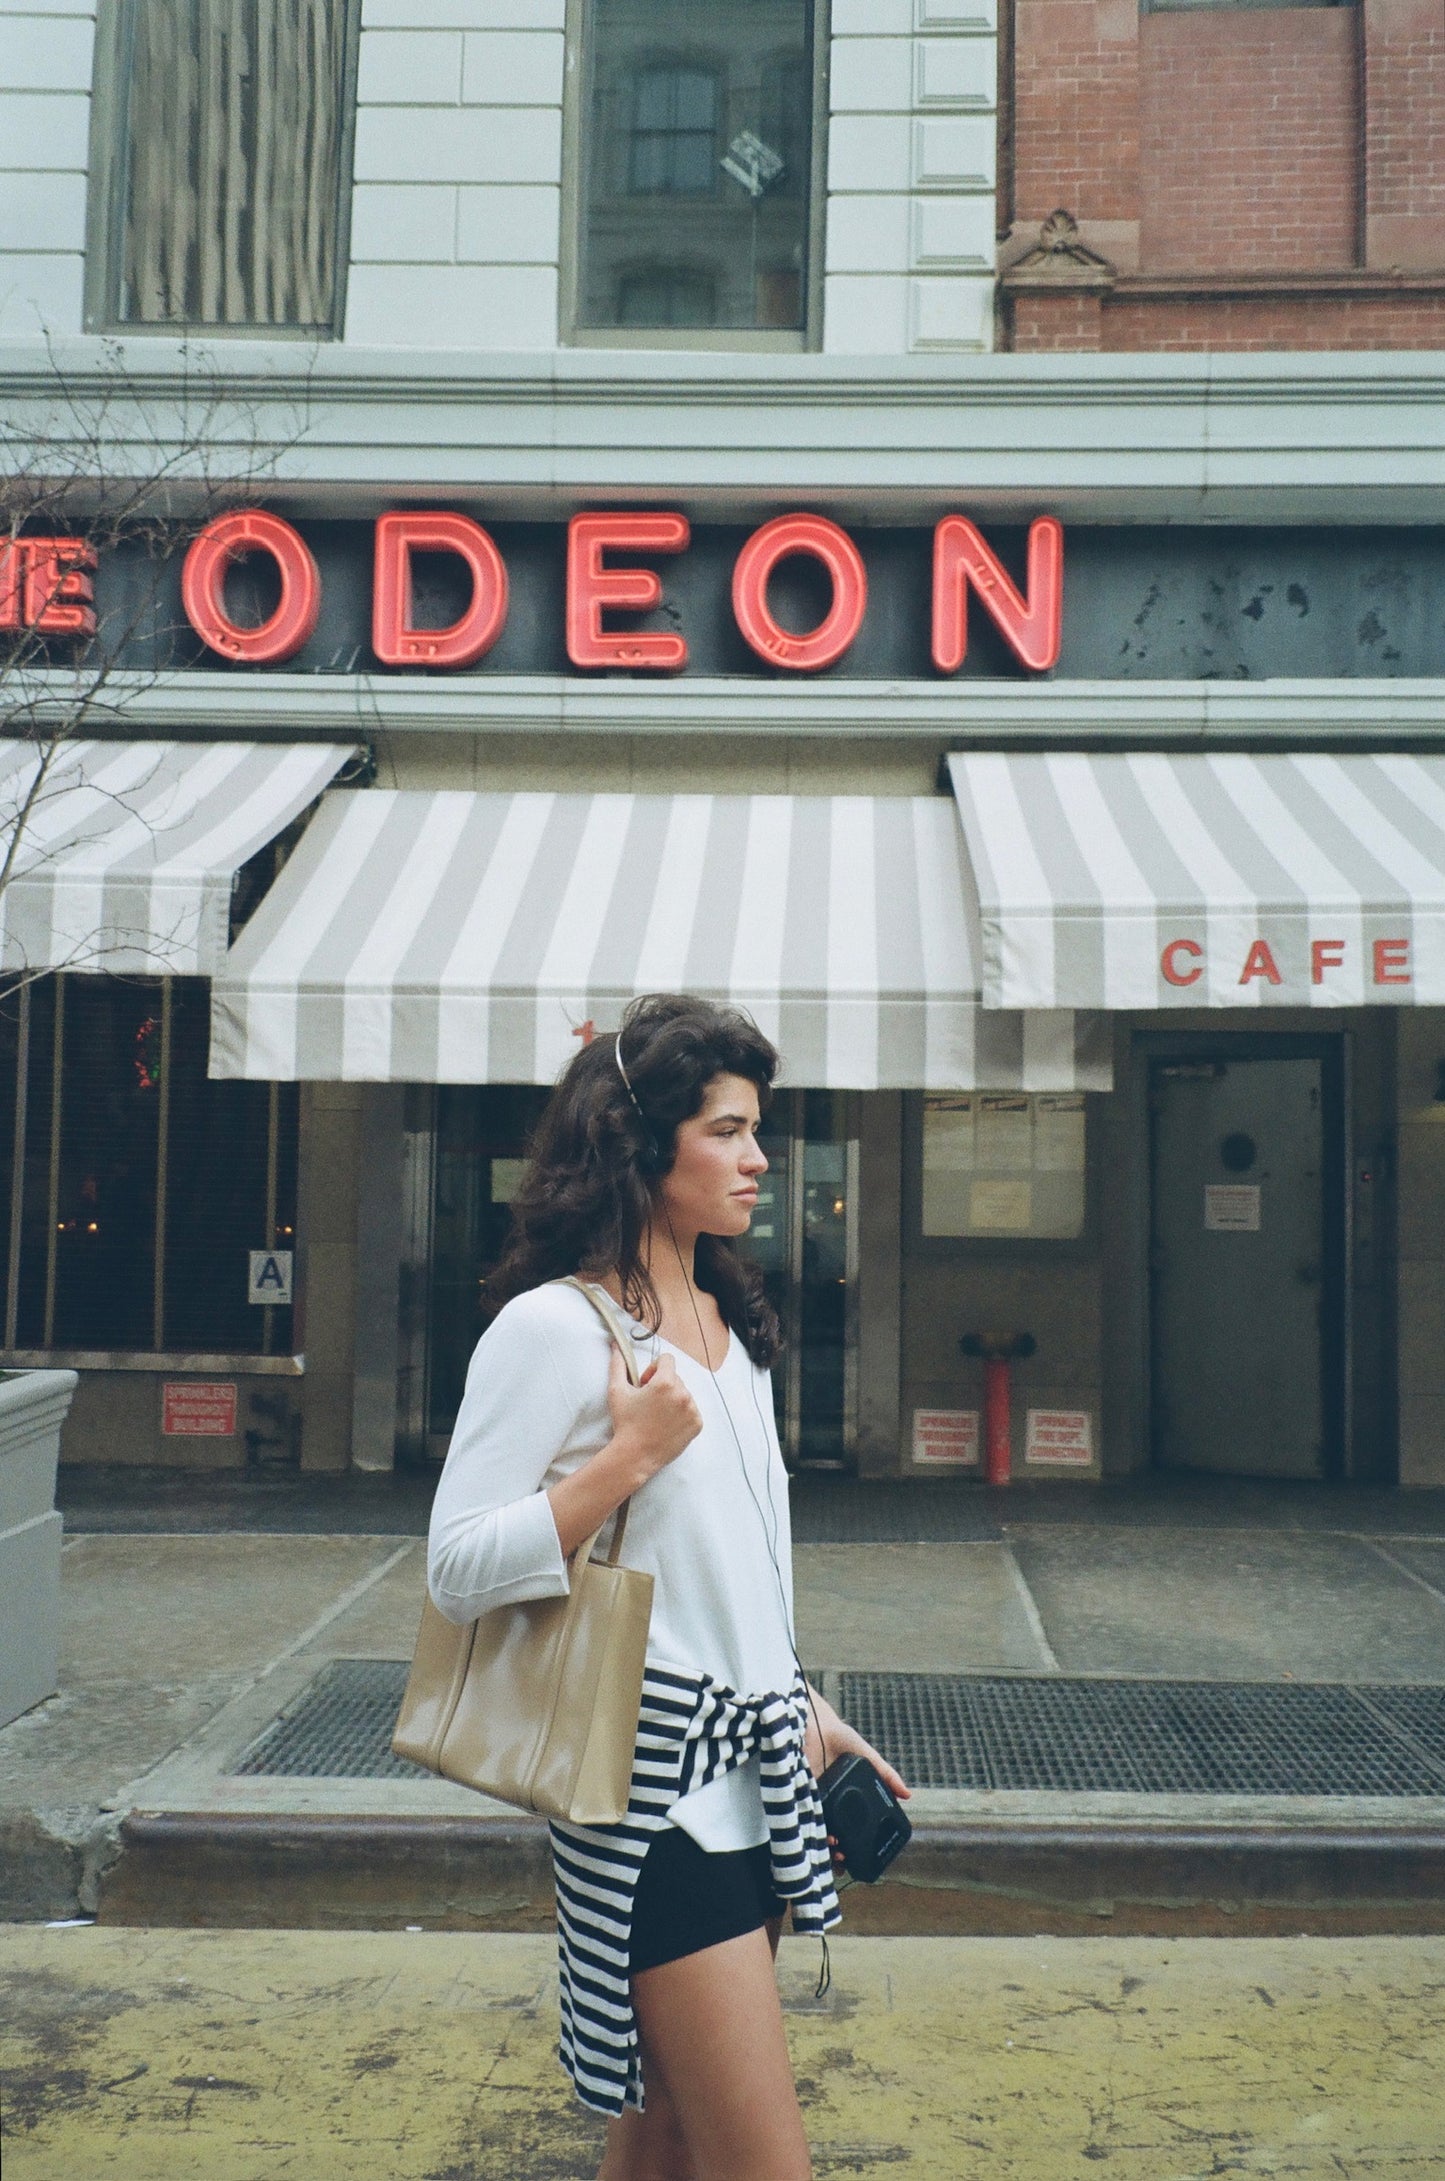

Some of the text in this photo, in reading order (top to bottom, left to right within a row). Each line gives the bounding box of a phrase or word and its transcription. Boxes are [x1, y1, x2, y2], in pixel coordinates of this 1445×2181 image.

[182, 508, 1064, 673] ODEON
[1160, 938, 1412, 986] CAFE
[256, 1256, 285, 1289] A
